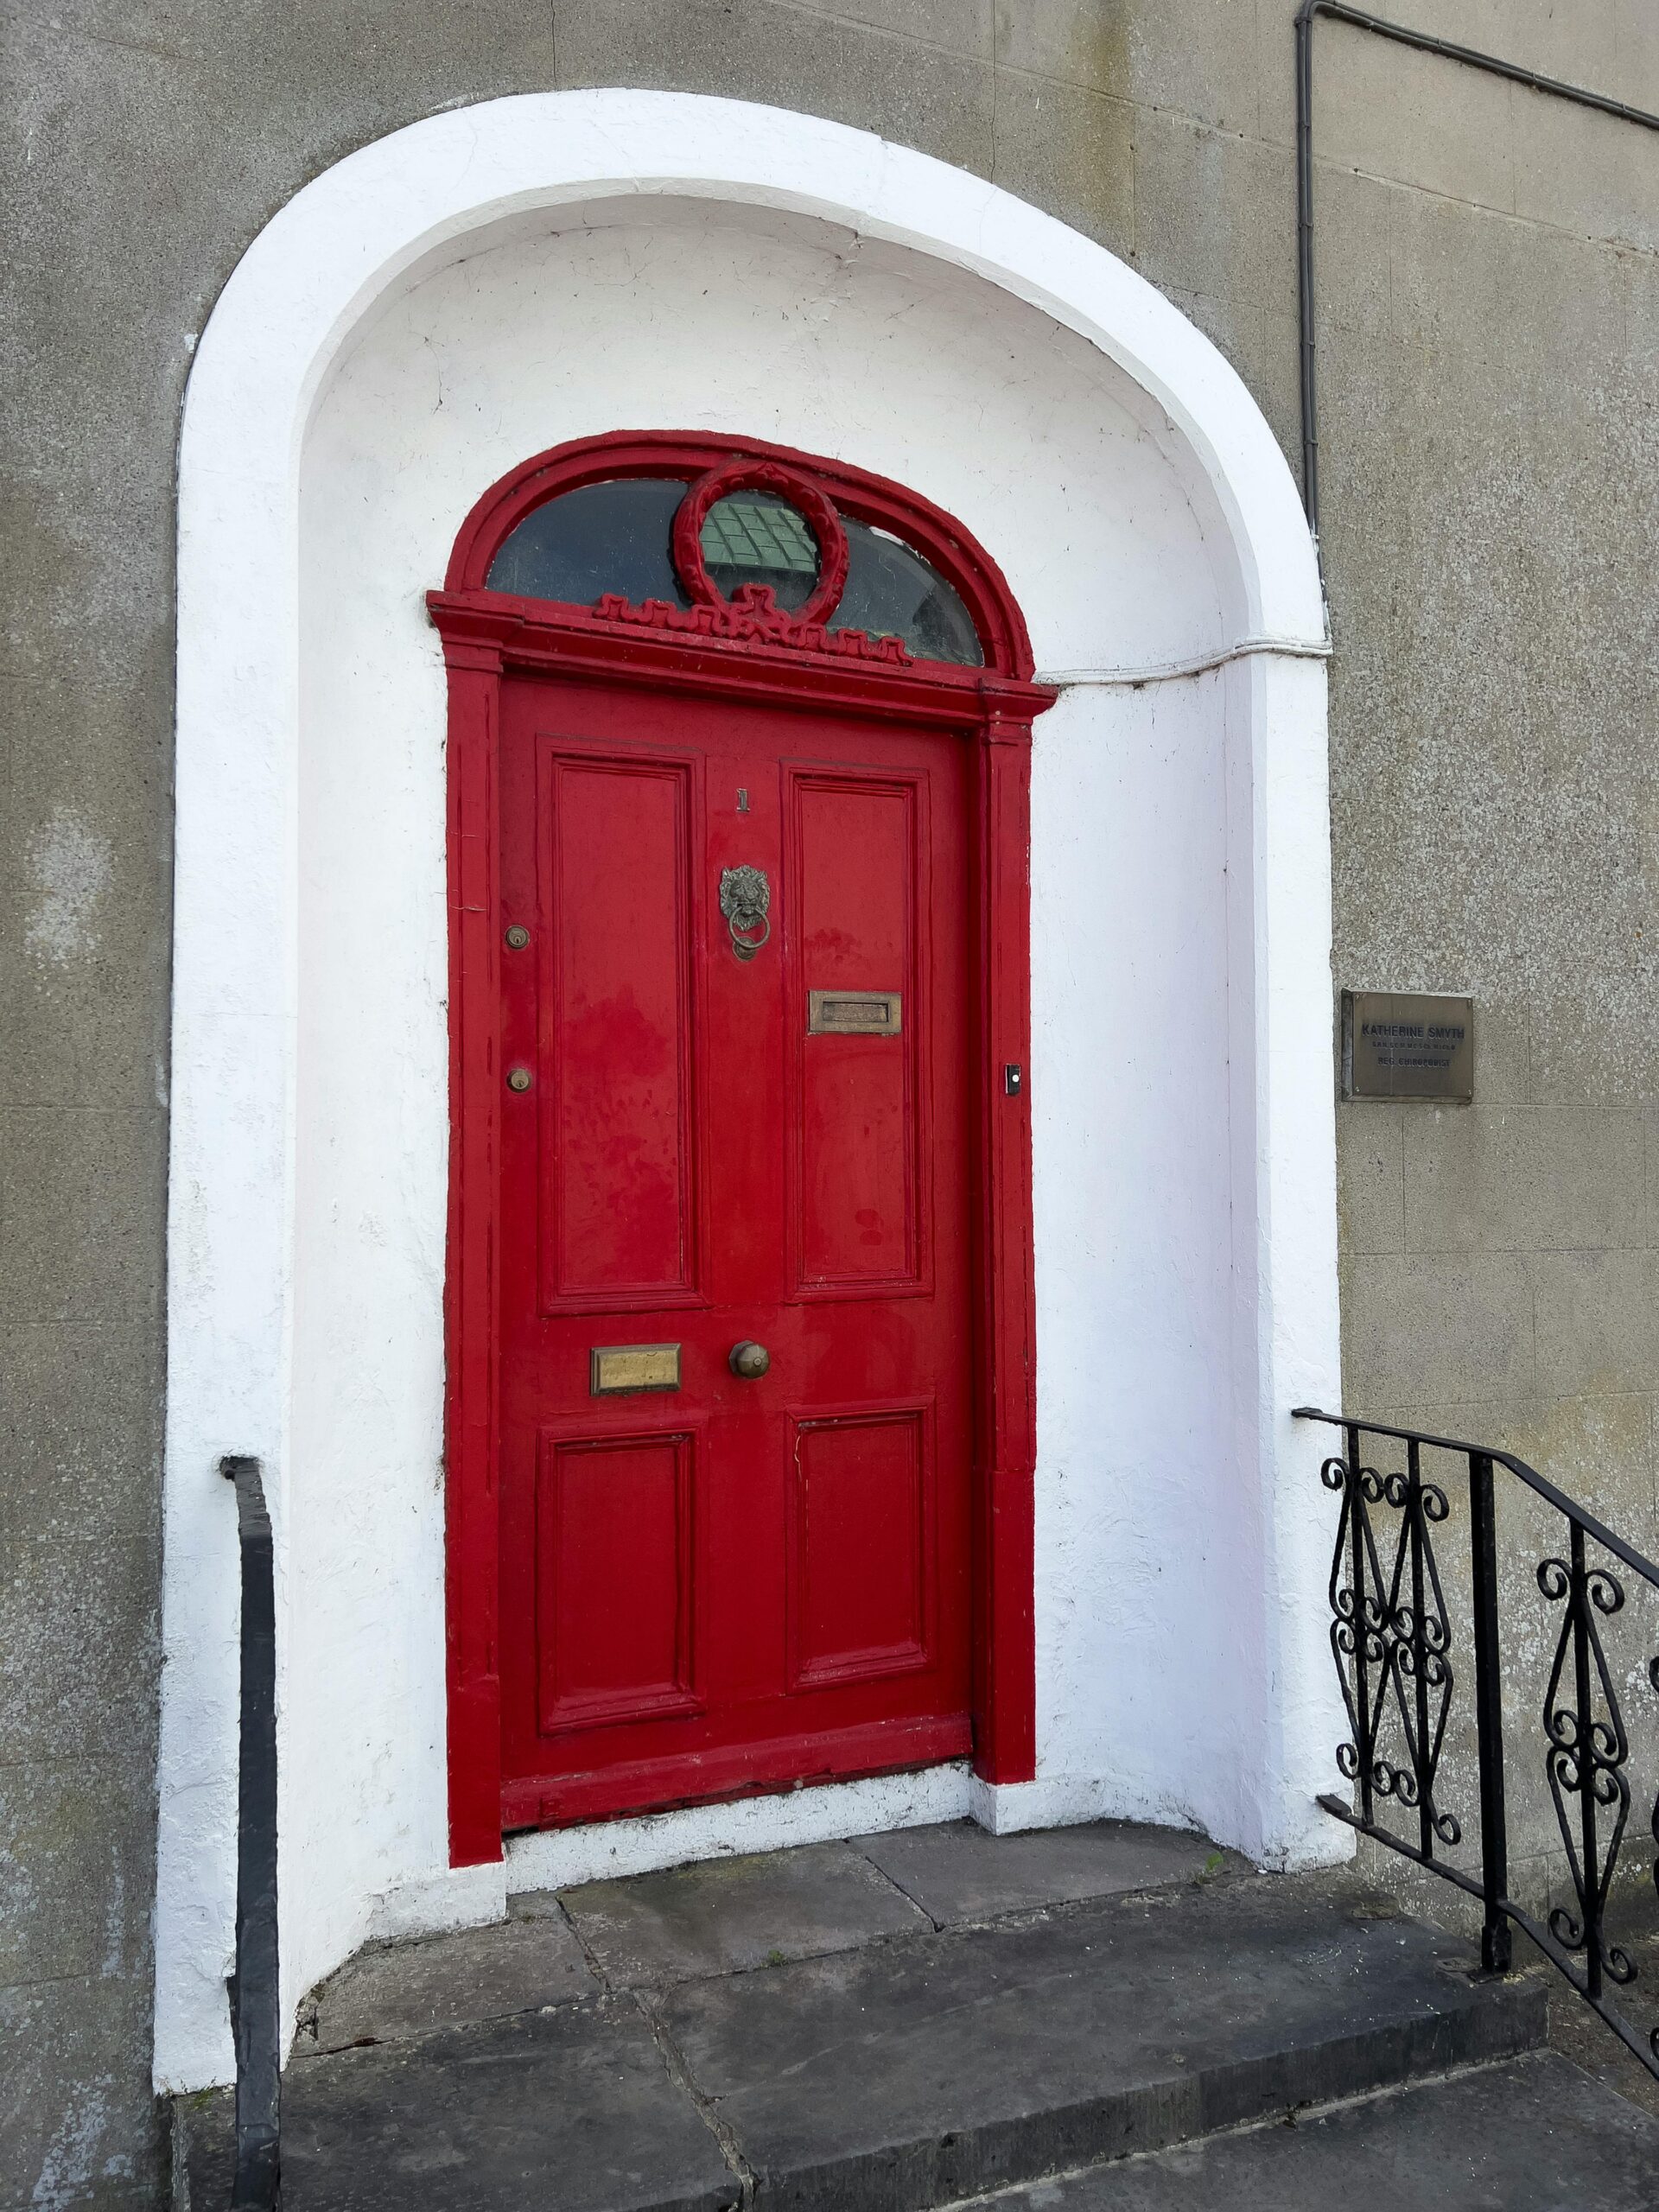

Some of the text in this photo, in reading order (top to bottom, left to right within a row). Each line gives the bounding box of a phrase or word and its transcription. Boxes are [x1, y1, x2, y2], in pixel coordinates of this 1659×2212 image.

[736, 788, 750, 812] 1
[1362, 1023, 1465, 1039] KATHERINE SMYTH
